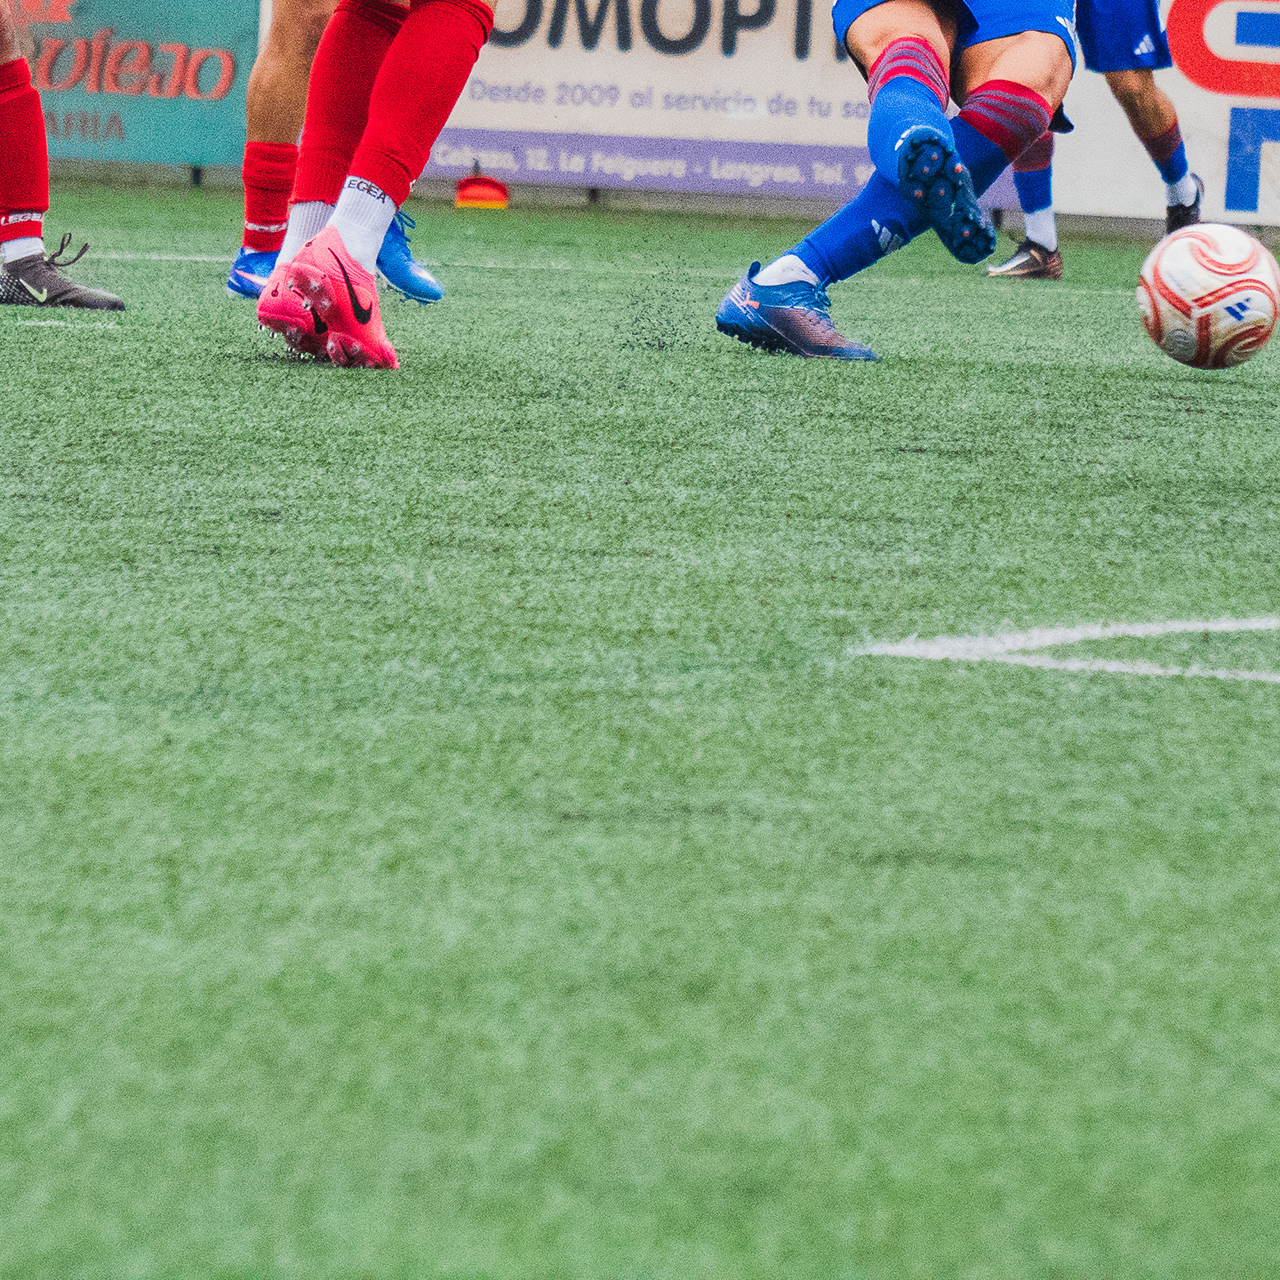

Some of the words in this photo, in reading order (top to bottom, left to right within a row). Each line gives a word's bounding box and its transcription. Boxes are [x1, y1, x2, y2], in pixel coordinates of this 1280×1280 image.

[470, 78, 546, 104] Desde
[556, 82, 620, 107] 2009
[629, 86, 653, 109] al
[663, 90, 757, 113] servicio
[767, 93, 798, 117] de
[808, 96, 832, 118] tu
[842, 100, 871, 119] sa
[342, 179, 386, 204] EGEA
[0, 212, 45, 226] LEGE
